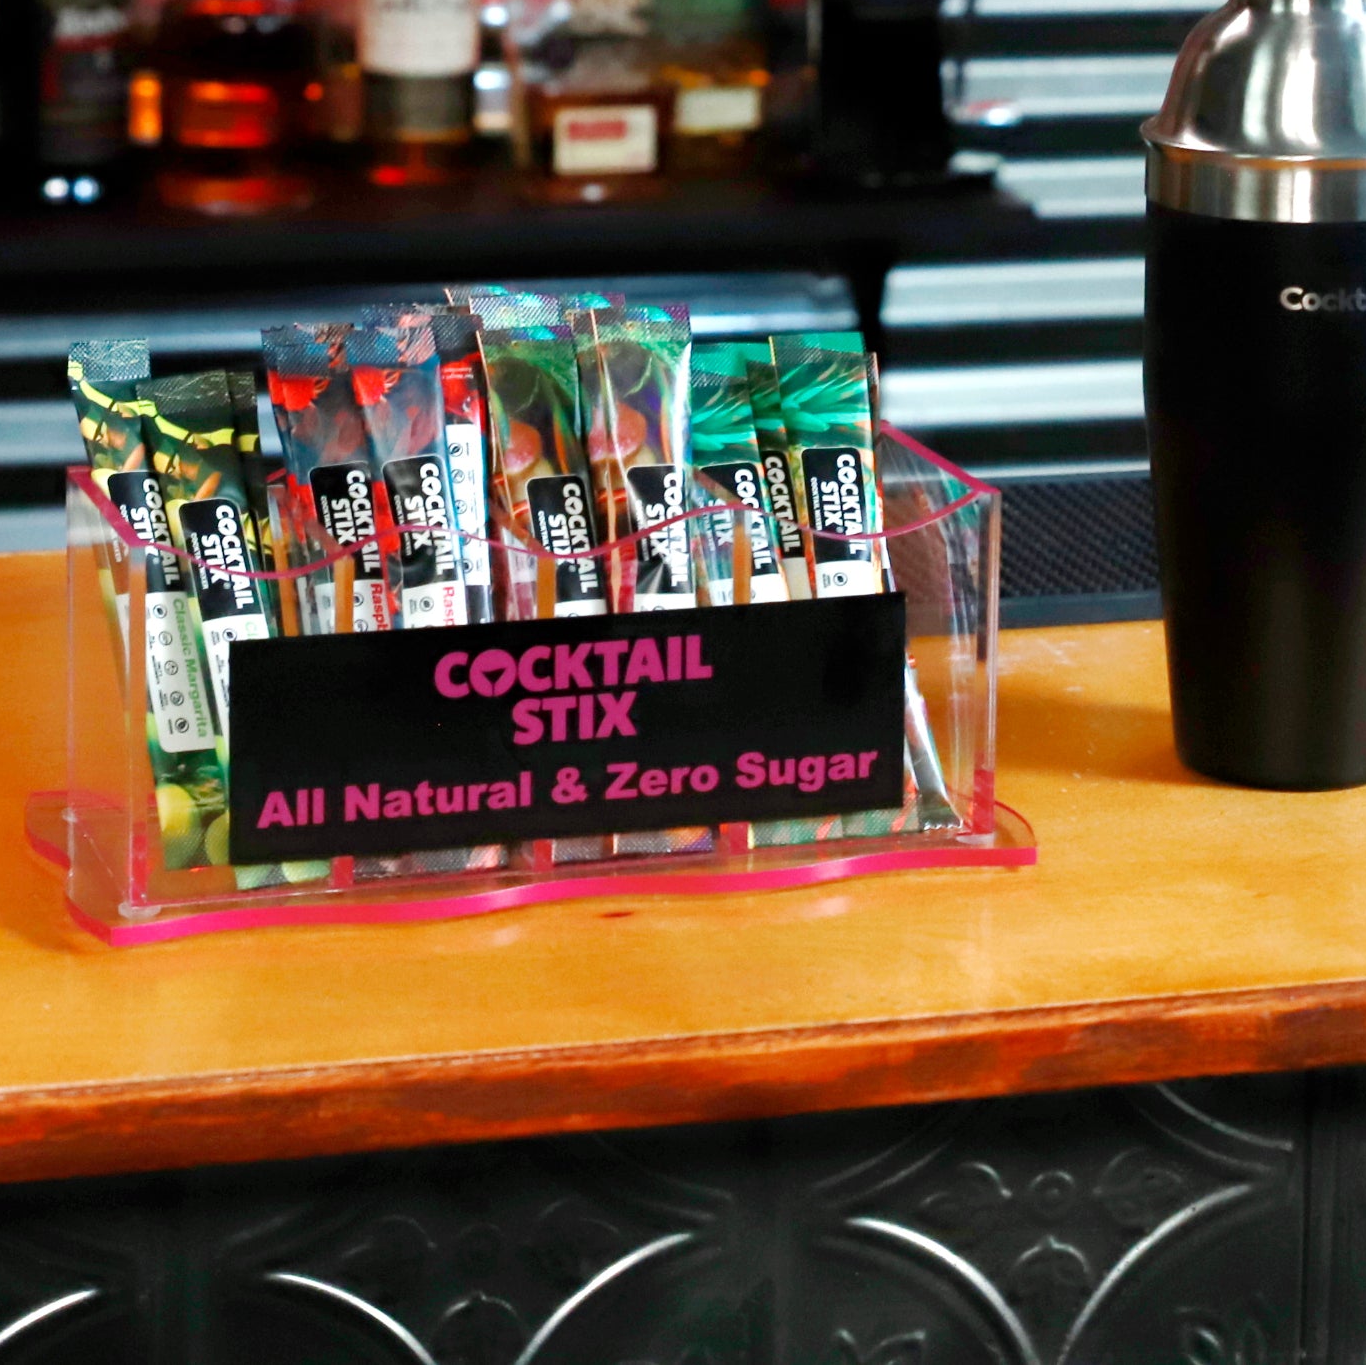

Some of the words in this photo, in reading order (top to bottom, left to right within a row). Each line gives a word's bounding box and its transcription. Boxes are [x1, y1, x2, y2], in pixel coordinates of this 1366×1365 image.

[142, 478, 180, 585] COCKTAIL
[331, 498, 357, 545] STIX
[346, 470, 381, 573] COCKTAIL
[404, 495, 433, 550] STX
[419, 463, 456, 576] COCKTAIL
[548, 514, 573, 565] STIX
[563, 483, 598, 594] COCKTAIL
[646, 503, 671, 562] STIX
[663, 472, 689, 587] COCKTAIL
[735, 469, 772, 569] COCKTAIL
[764, 456, 801, 553] COCKTAIL
[821, 480, 843, 527] STIX
[836, 454, 868, 555] COCKTAIL
[201, 533, 230, 584] STIX
[216, 505, 254, 610] COCKTAIL
[172, 598, 193, 657] Classic
[185, 658, 208, 738] Margarita
[435, 635, 712, 699] COCKTAIL
[512, 690, 636, 745] STIX
[256, 788, 324, 829] All
[343, 771, 531, 822] Natural
[551, 767, 587, 805] &
[604, 762, 719, 800] Zero
[736, 748, 878, 793] Sugar
